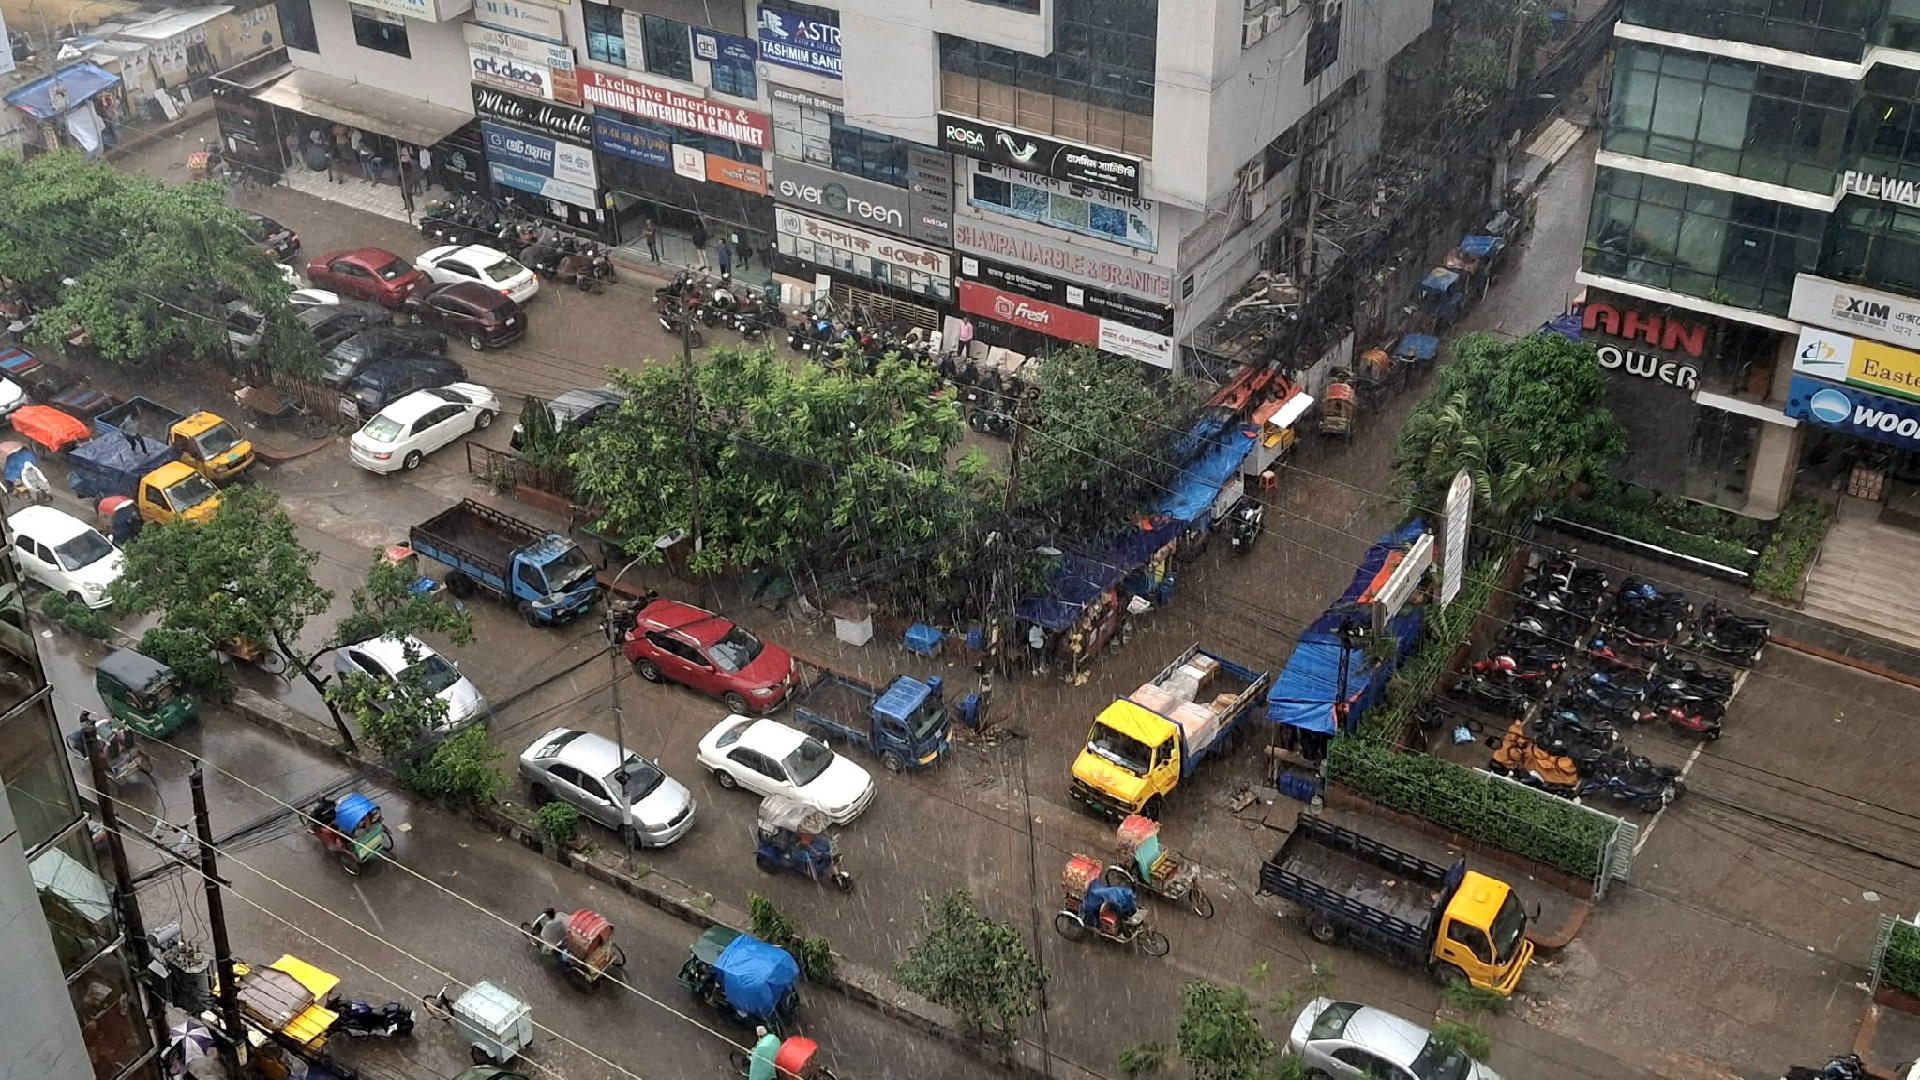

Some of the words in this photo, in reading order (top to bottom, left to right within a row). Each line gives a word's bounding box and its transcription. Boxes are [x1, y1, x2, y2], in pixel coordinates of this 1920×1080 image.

[548, 48, 568, 60] আর্ট
[760, 40, 810, 62] TASHMIM
[473, 56, 501, 74] art
[502, 61, 543, 86] deco
[475, 89, 525, 119] White
[528, 106, 592, 135] Marble
[583, 84, 634, 111] BUILDING
[636, 101, 697, 130] MATERIALS
[594, 73, 662, 102] Exclusive
[666, 91, 731, 121] Interiors
[735, 110, 750, 125] &
[946, 125, 985, 146] ROSA
[955, 225, 1019, 257] SHAMPA
[1020, 244, 1084, 275] MARBLE
[1086, 262, 1098, 279] &
[1099, 264, 1170, 298] GRANITE
[1014, 302, 1049, 325] Fresh
[1833, 294, 1890, 320] EXIM
[1596, 345, 1698, 391] OWER
